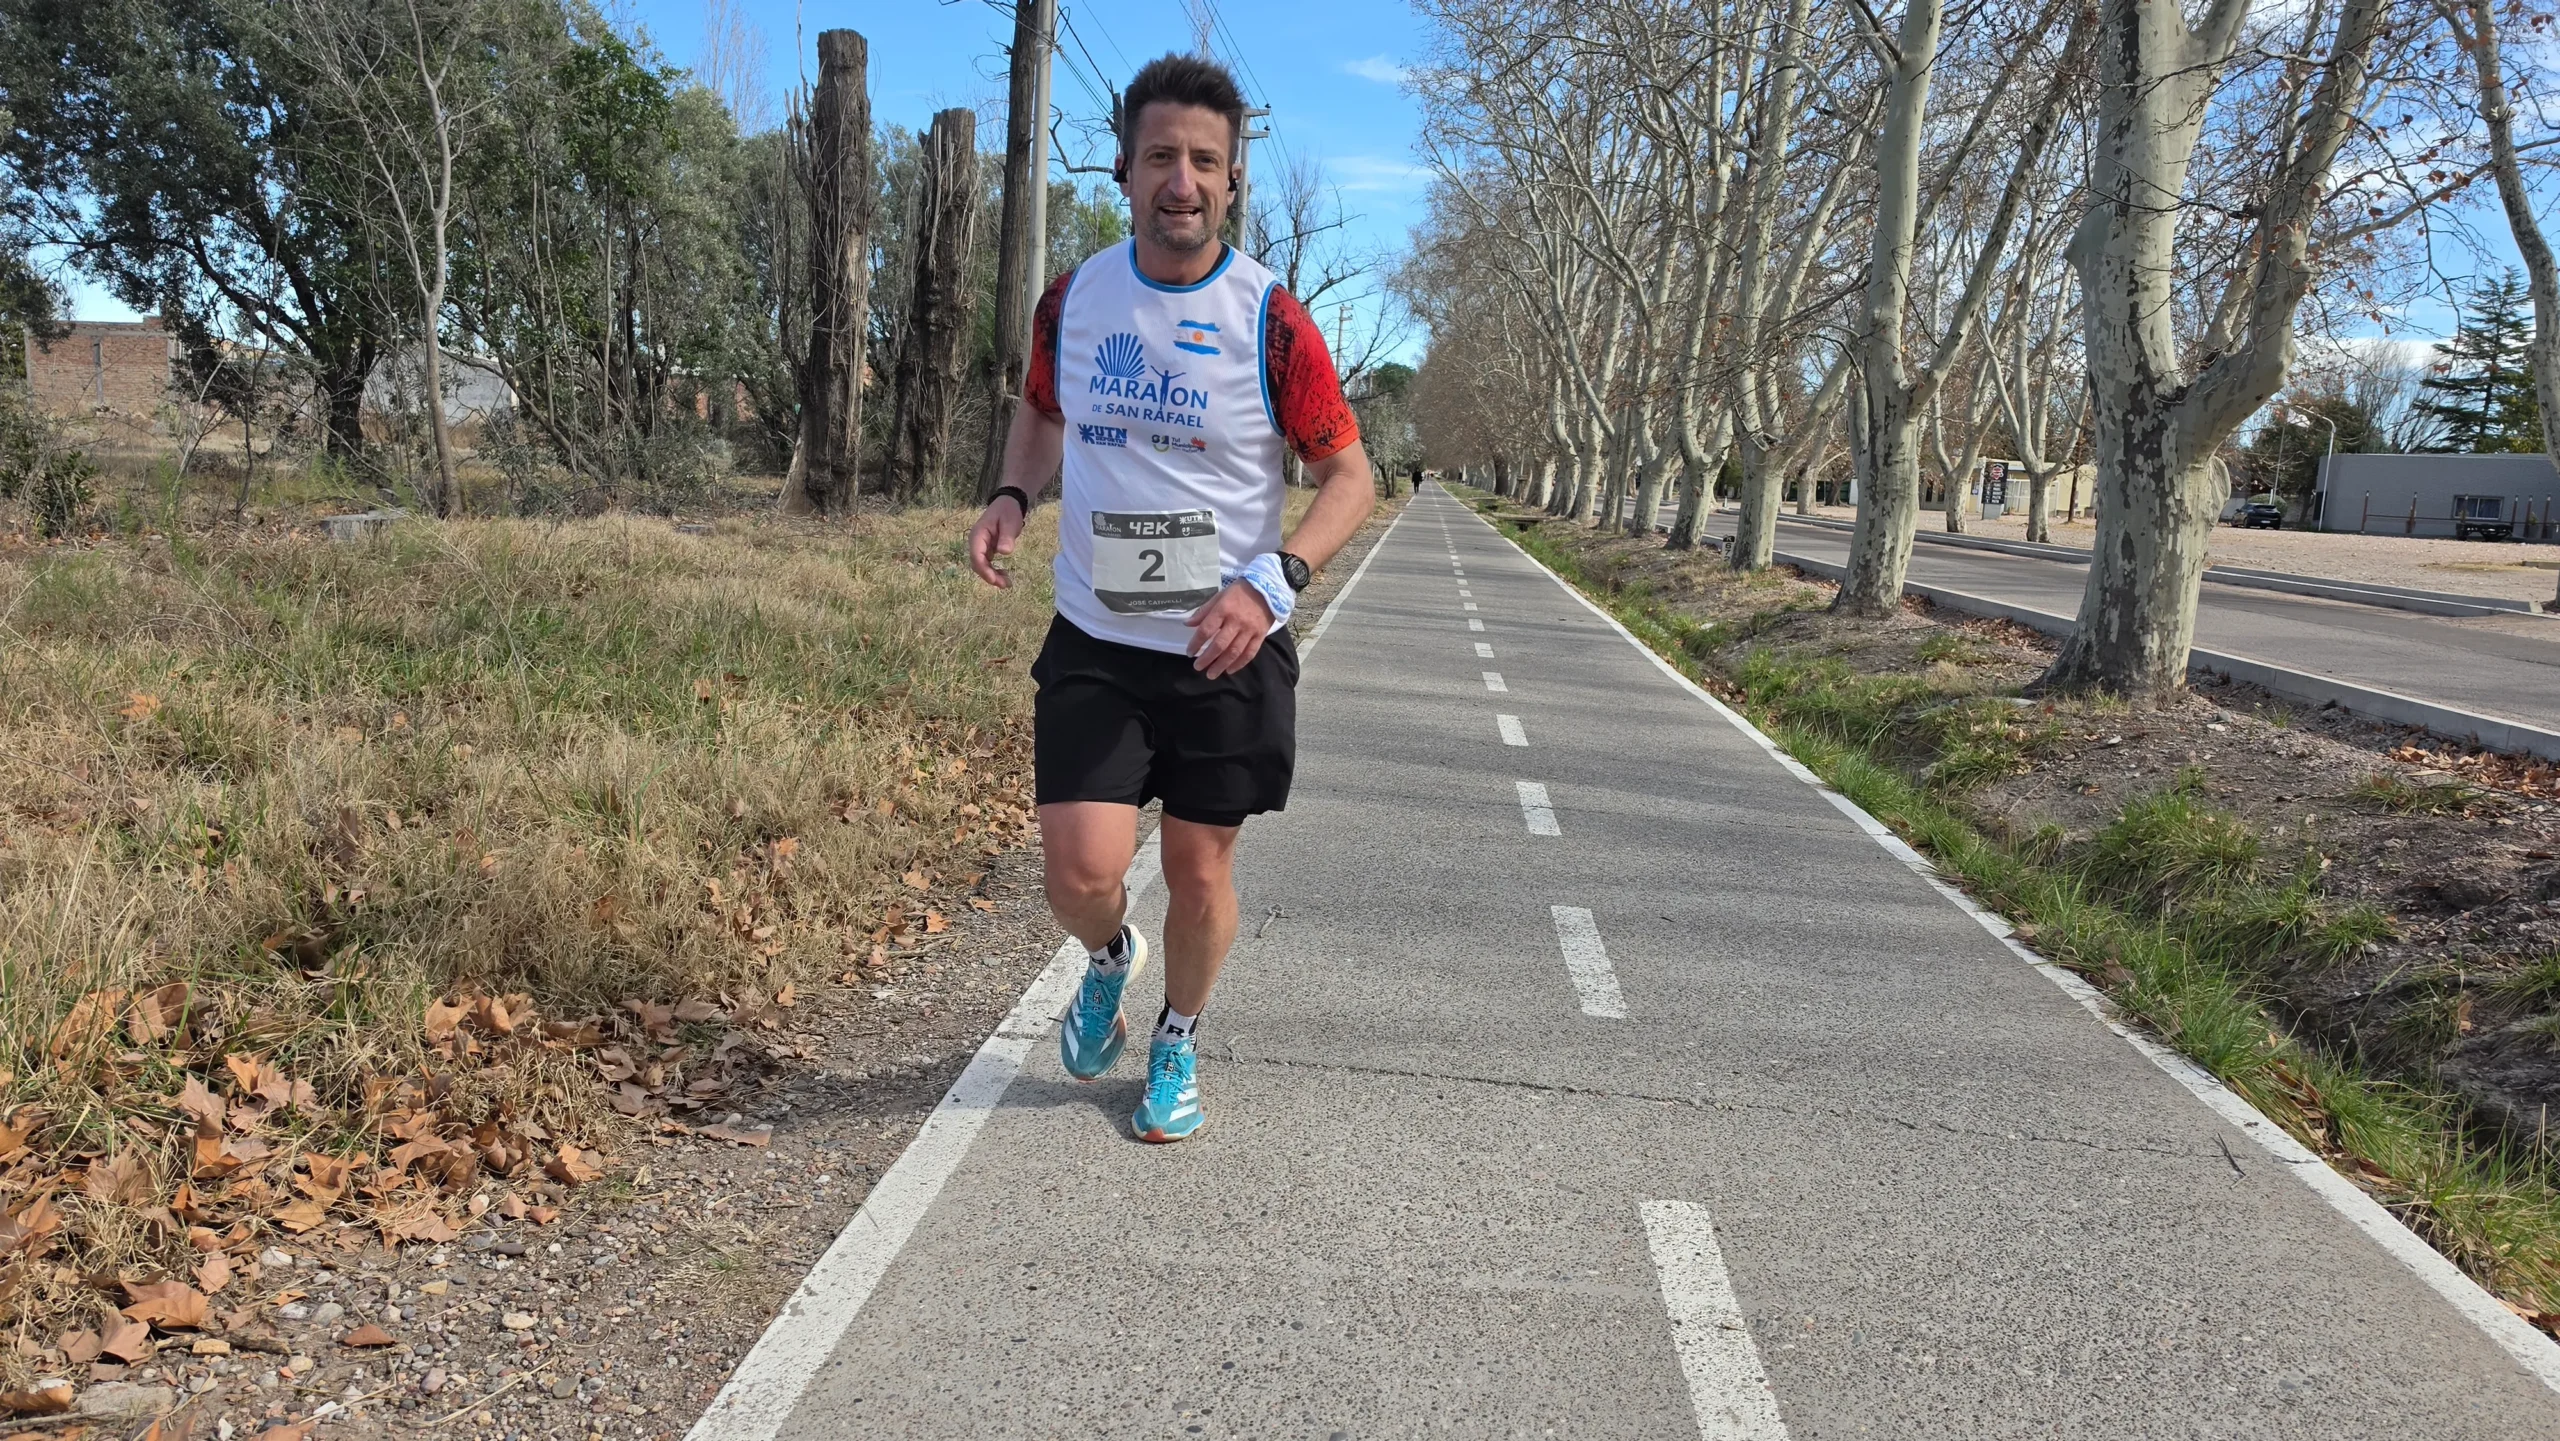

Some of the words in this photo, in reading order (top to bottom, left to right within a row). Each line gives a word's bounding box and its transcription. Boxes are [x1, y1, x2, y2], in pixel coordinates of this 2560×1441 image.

[1089, 374, 1208, 410] MARATON
[1092, 404, 1102, 413] DE
[1105, 403, 1139, 419] SAN
[1143, 408, 1204, 428] RAFAEL
[1094, 425, 1127, 440] UTN
[1129, 521, 1171, 535] 42K
[1138, 549, 1166, 582] 2
